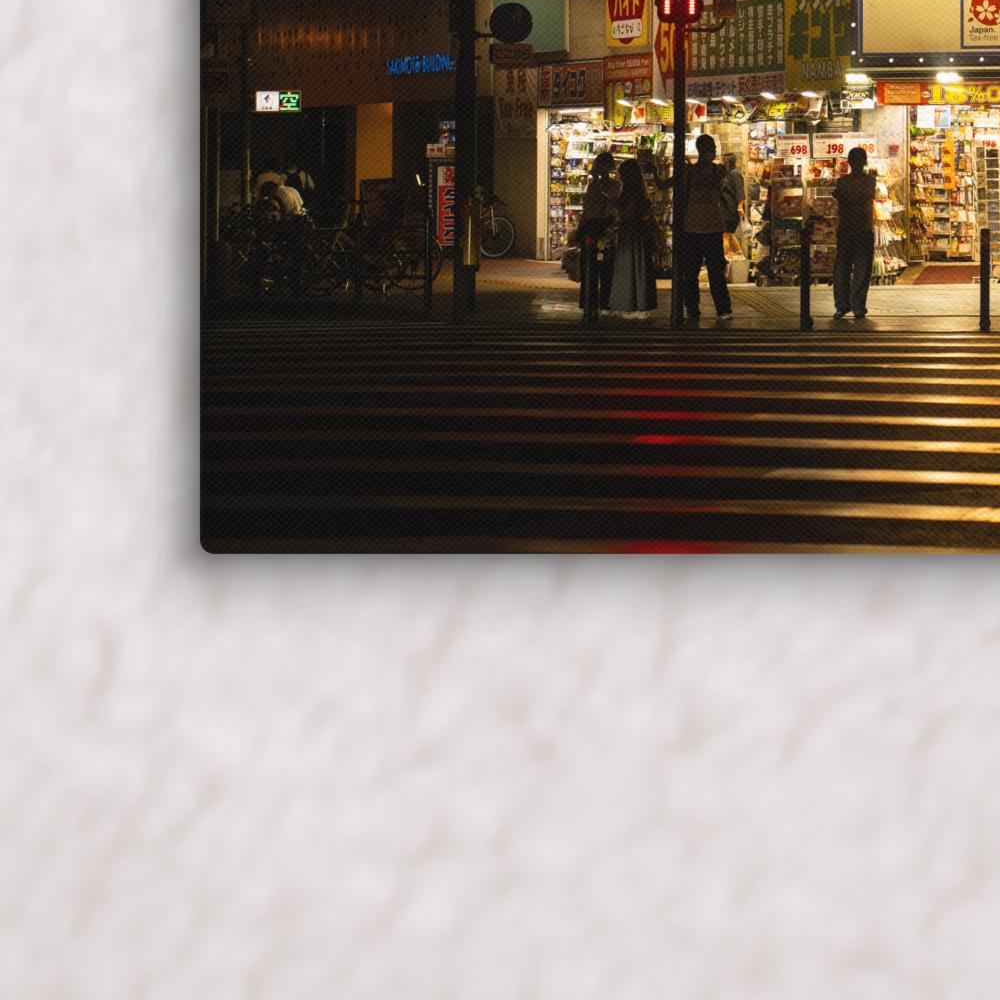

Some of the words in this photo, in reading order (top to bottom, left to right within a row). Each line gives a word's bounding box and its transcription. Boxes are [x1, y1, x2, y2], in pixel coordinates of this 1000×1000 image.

[802, 60, 841, 82] NAMBA
[280, 92, 299, 111] 空
[790, 145, 808, 156] 698
[827, 144, 844, 154] 198
